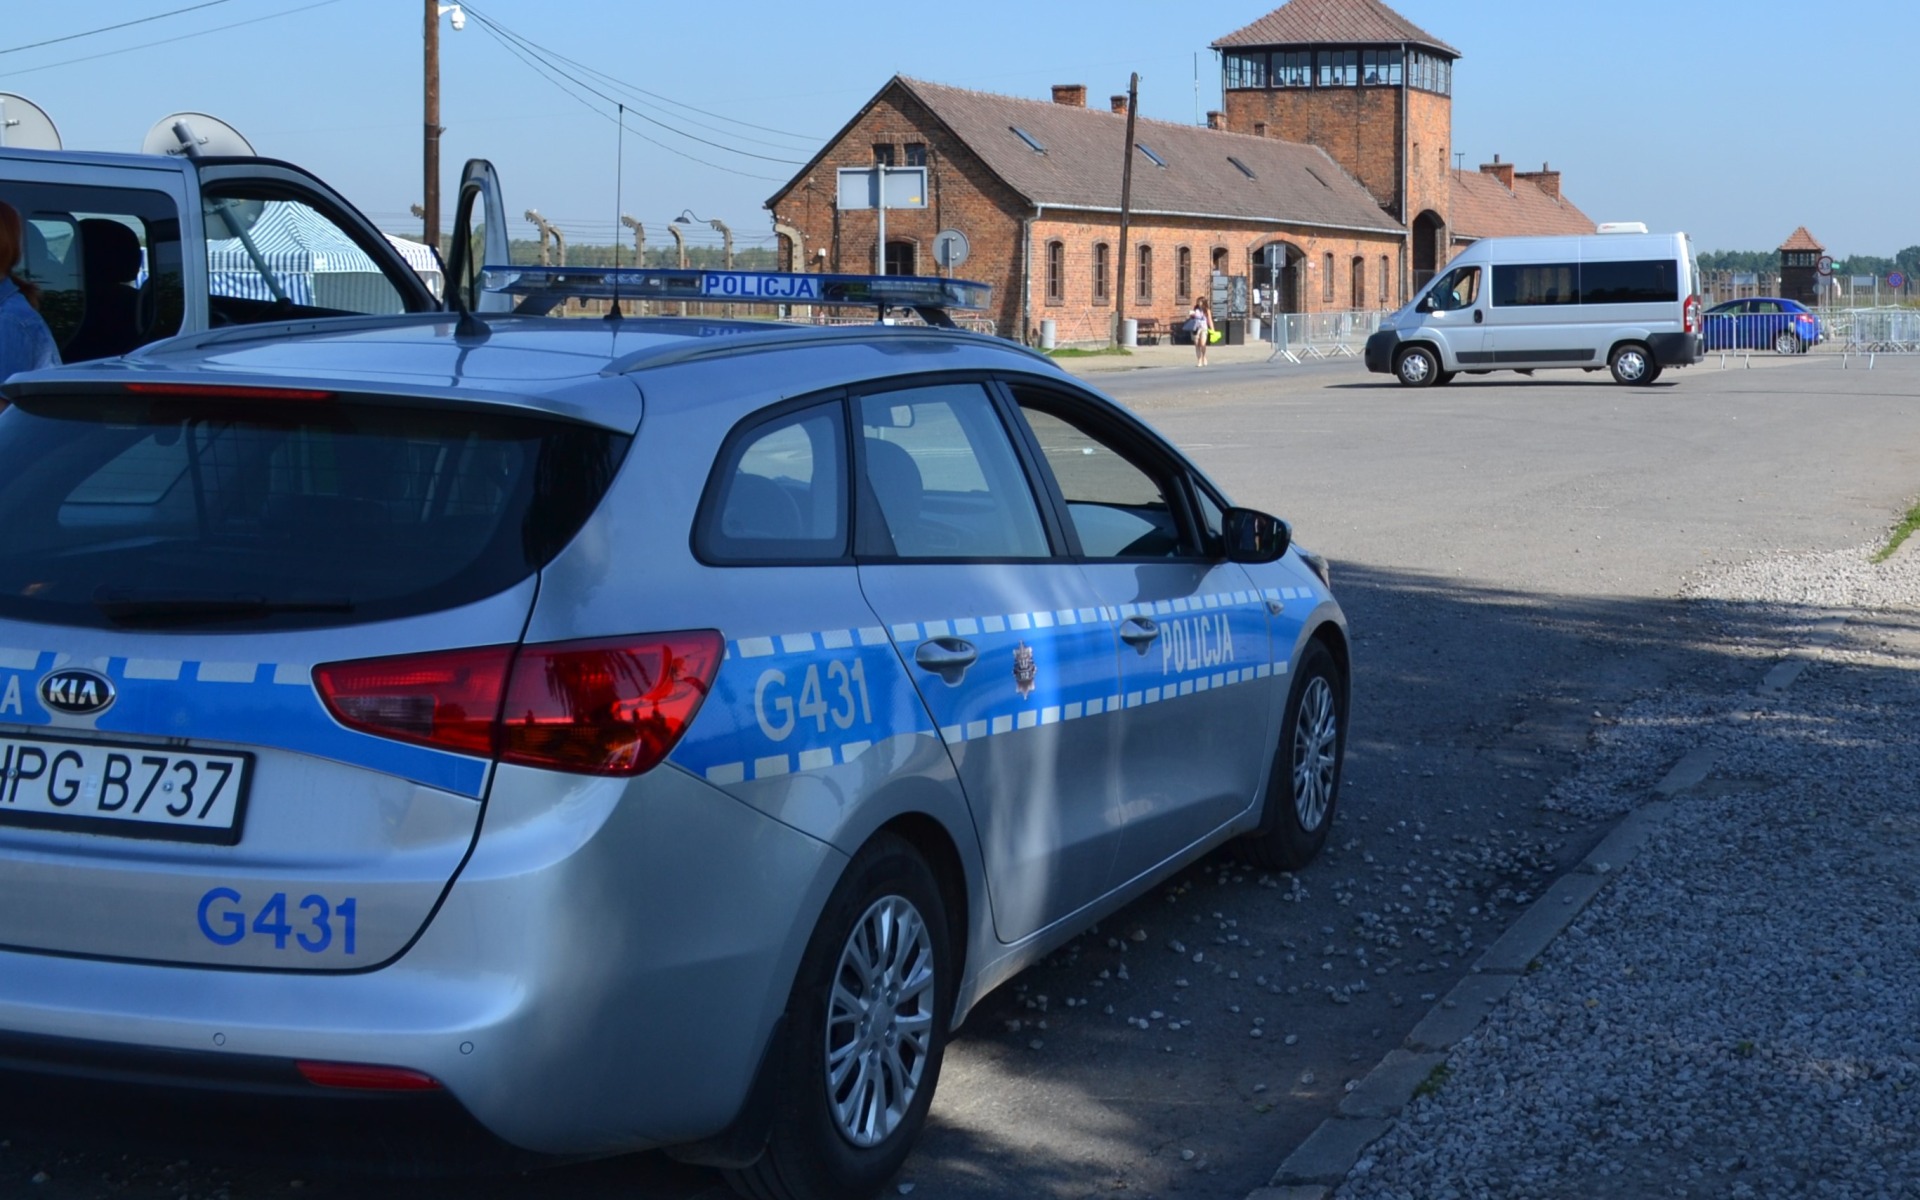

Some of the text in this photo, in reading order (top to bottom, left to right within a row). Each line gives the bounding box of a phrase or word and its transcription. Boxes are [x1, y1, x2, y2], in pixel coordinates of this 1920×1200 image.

[705, 275, 815, 298] POLICJA
[1160, 613, 1234, 676] POLICJA
[49, 678, 99, 705] KIA
[755, 657, 872, 741] G431
[98, 753, 234, 819] B737
[197, 887, 357, 955] G431
